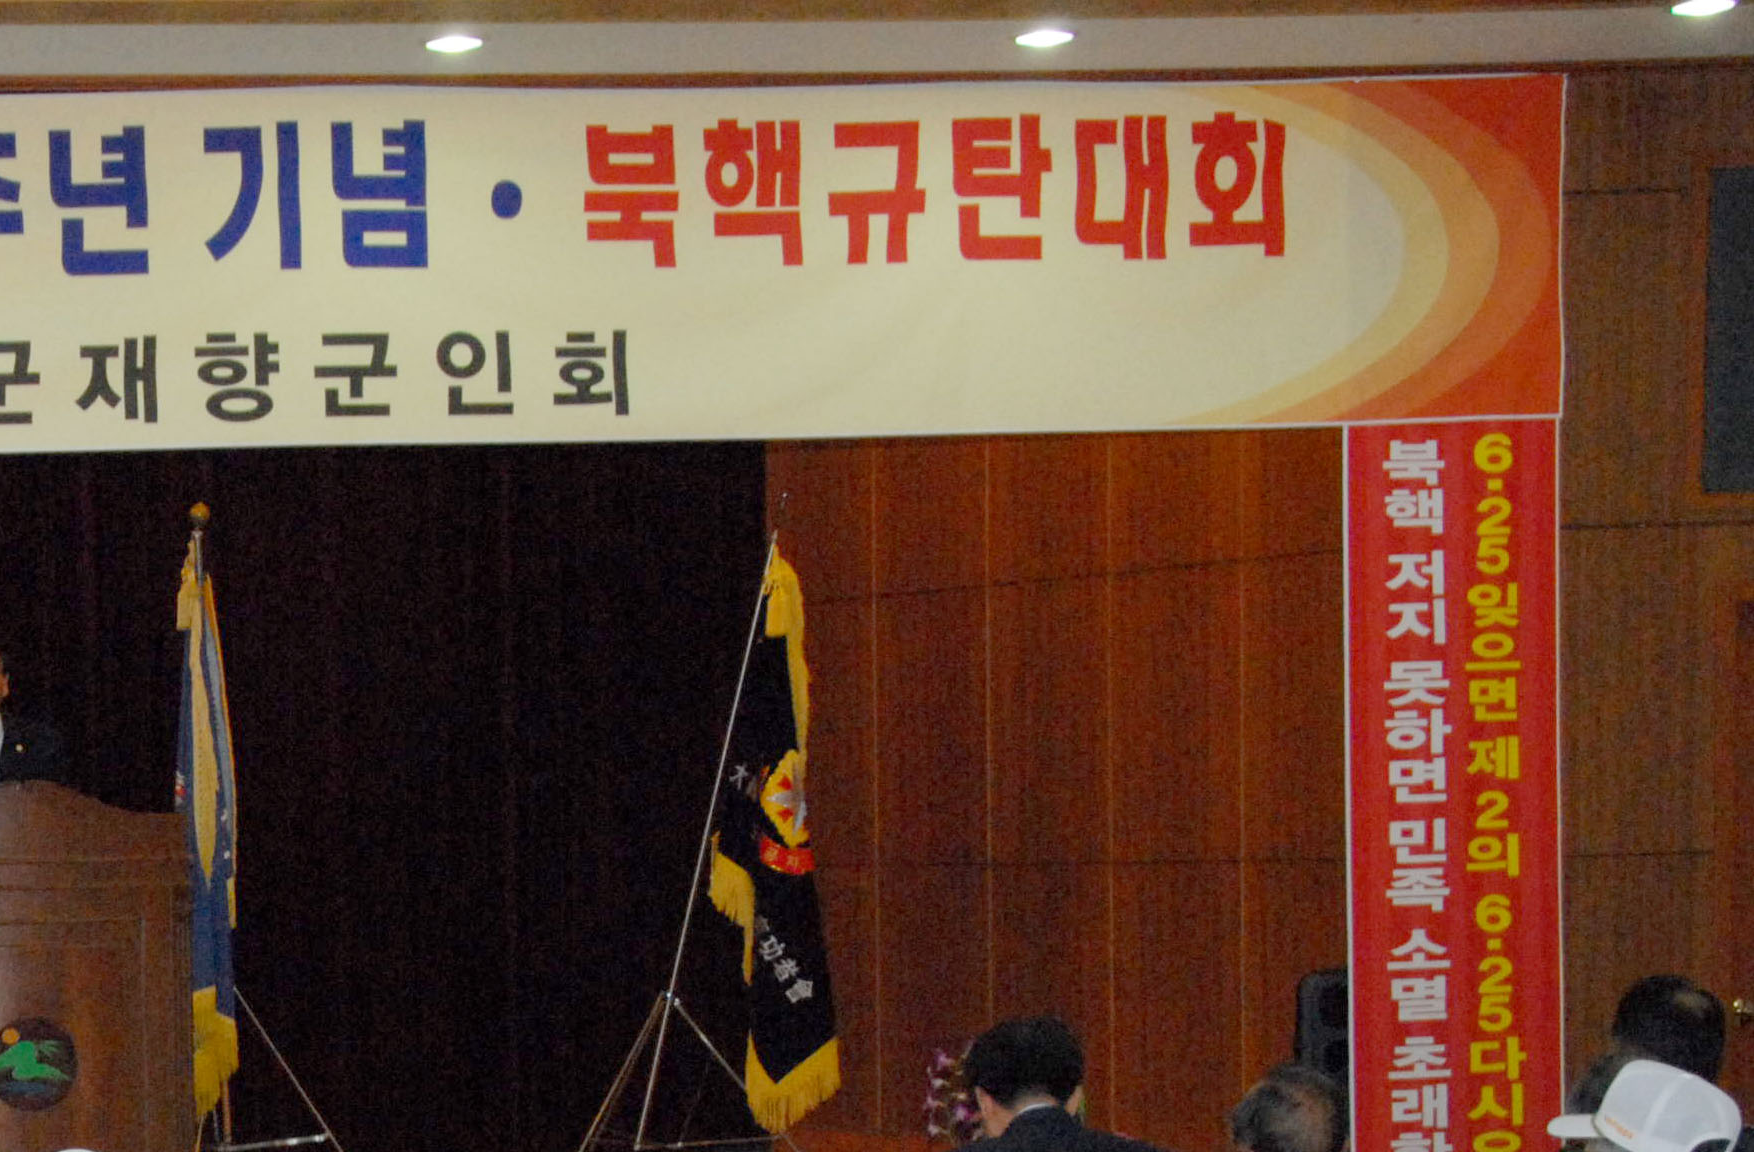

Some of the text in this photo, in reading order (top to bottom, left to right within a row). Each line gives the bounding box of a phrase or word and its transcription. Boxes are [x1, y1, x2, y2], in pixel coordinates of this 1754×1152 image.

[1382, 438, 1447, 535] 북핵
[1384, 549, 1447, 645] 저지
[1383, 660, 1453, 804] 못하면
[1385, 817, 1451, 912] 민족
[1386, 928, 1452, 1022] 소멸
